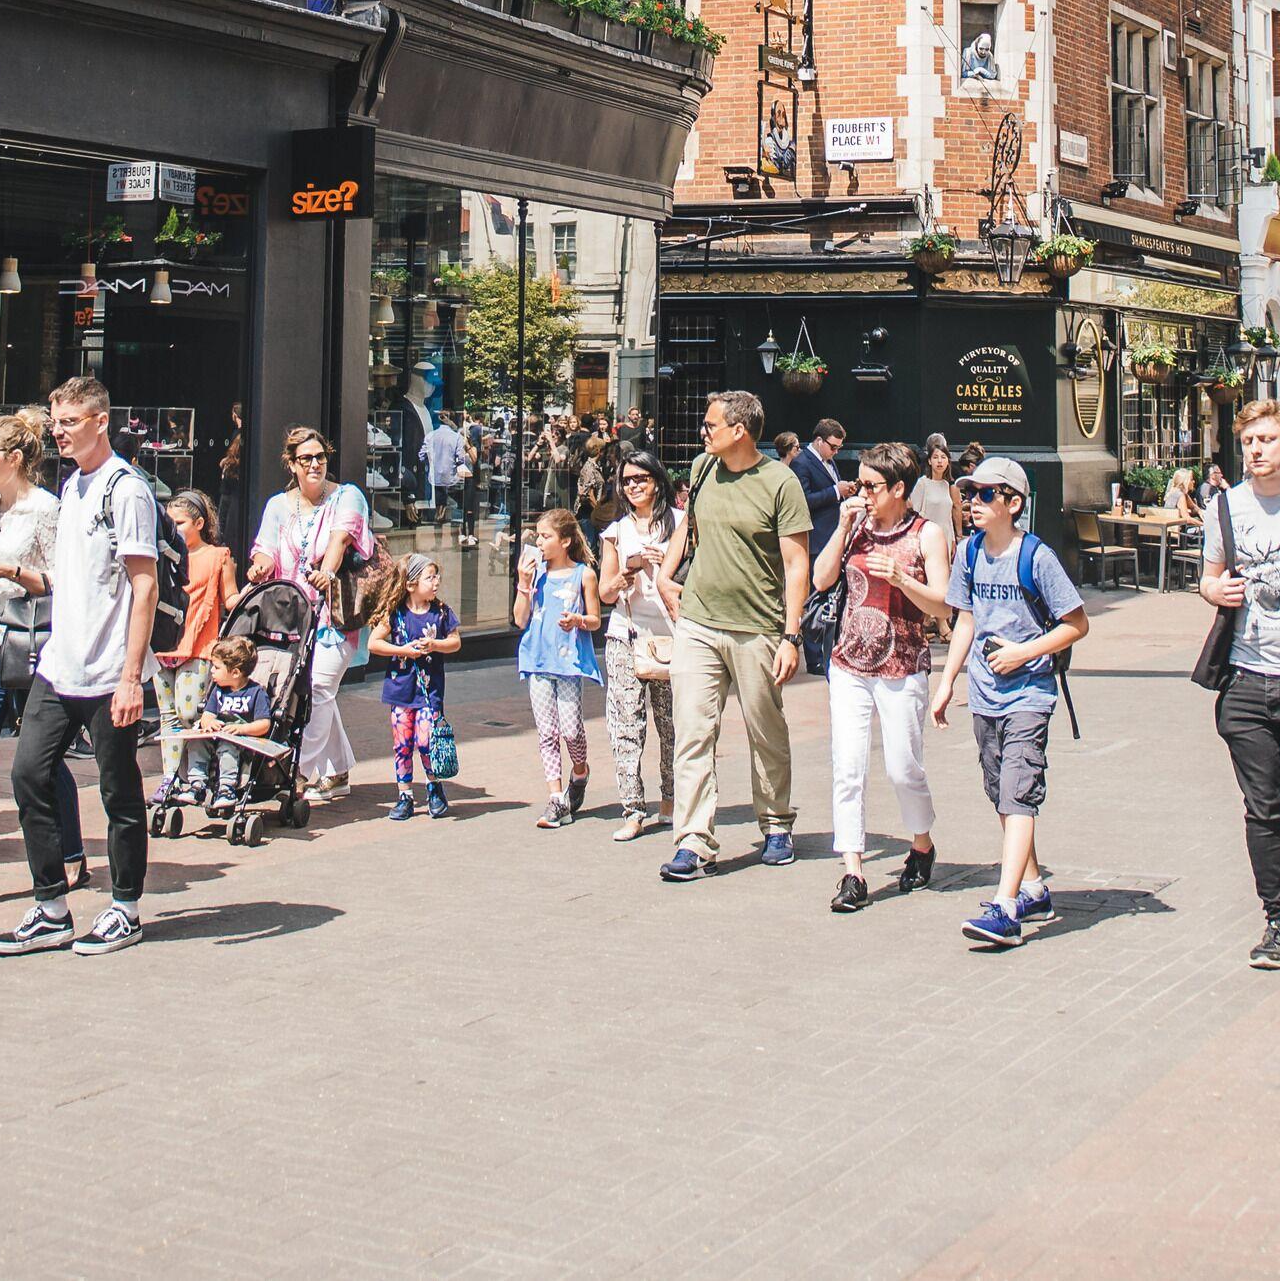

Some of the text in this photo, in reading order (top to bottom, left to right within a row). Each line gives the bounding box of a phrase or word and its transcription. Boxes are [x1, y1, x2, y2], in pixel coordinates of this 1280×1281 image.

[832, 122, 886, 134] FOUBERT'S
[832, 135, 880, 147] PLACE W1
[292, 181, 359, 214] size?
[1131, 234, 1192, 257] SHAKESPEARE'S HEAD
[958, 347, 1021, 366] PURVEYOR OF
[970, 366, 1008, 374] QUALITY
[956, 384, 1022, 398] CASK ALES
[956, 403, 994, 411] CRAFTED
[975, 582, 1024, 601] TREETSTY
